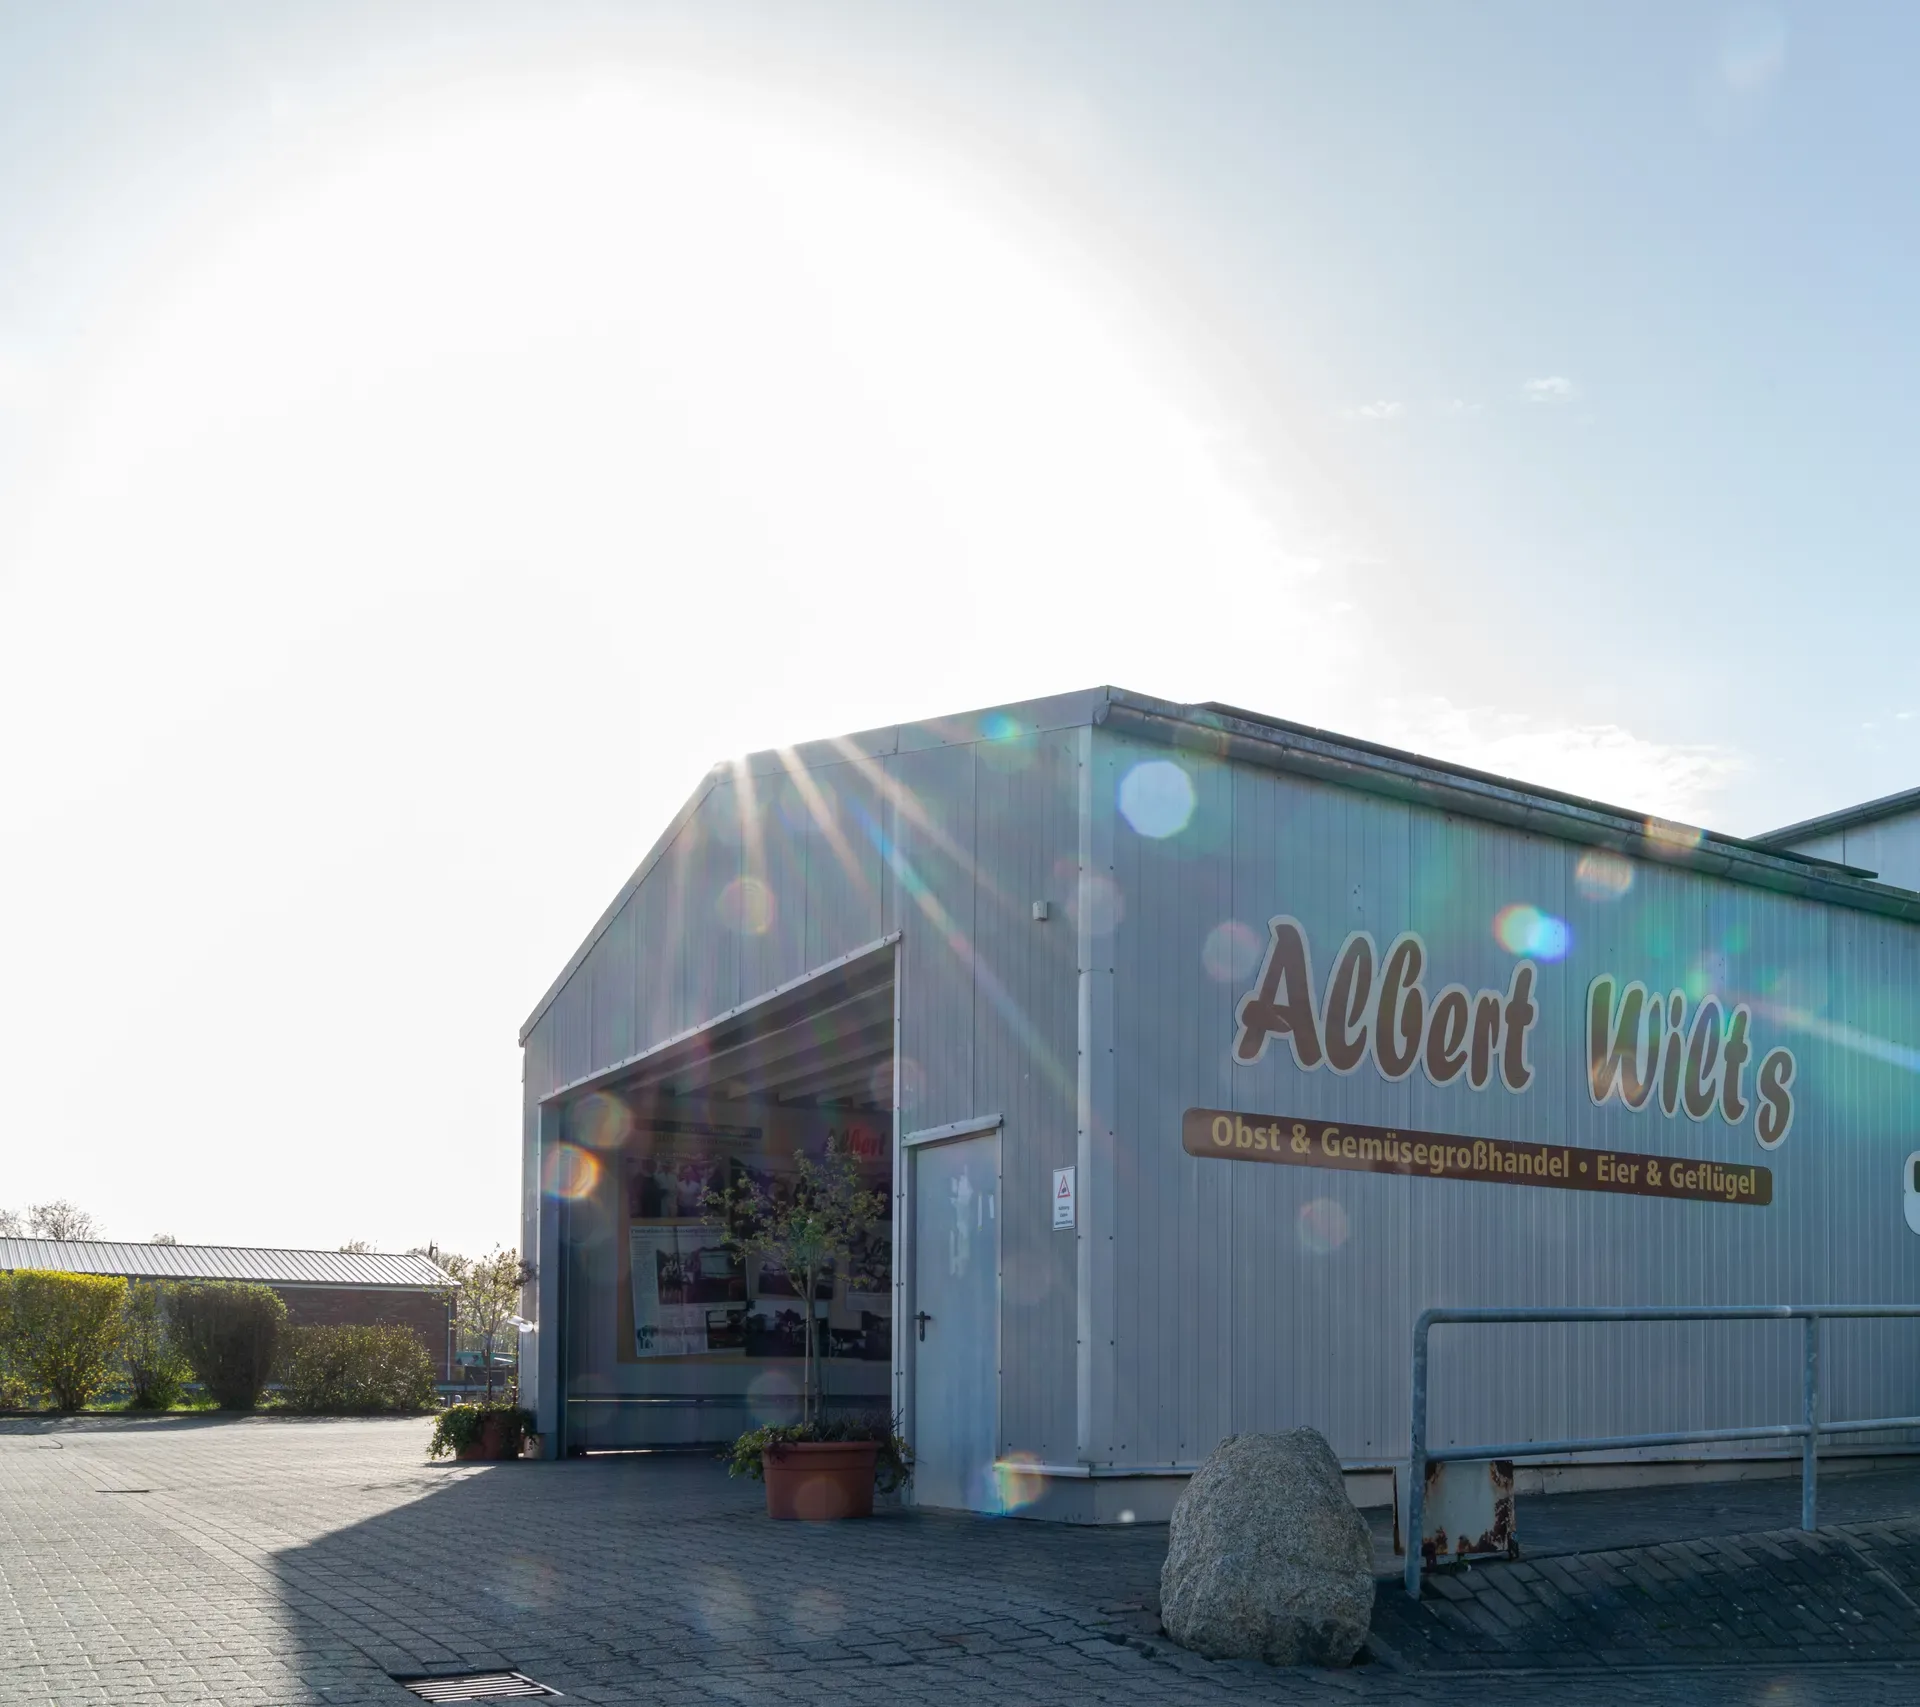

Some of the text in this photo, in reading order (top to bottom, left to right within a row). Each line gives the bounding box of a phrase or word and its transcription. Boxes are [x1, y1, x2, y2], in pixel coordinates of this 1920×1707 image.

[1236, 921, 1794, 1145] Albert Wilts
[1212, 1116, 1280, 1152] Obst
[1290, 1124, 1311, 1154] &
[1321, 1128, 1570, 1178] Gemüsegroßhandel
[1597, 1155, 1640, 1184] Eier
[1646, 1159, 1663, 1187] &
[1669, 1162, 1756, 1200] Geflügel
